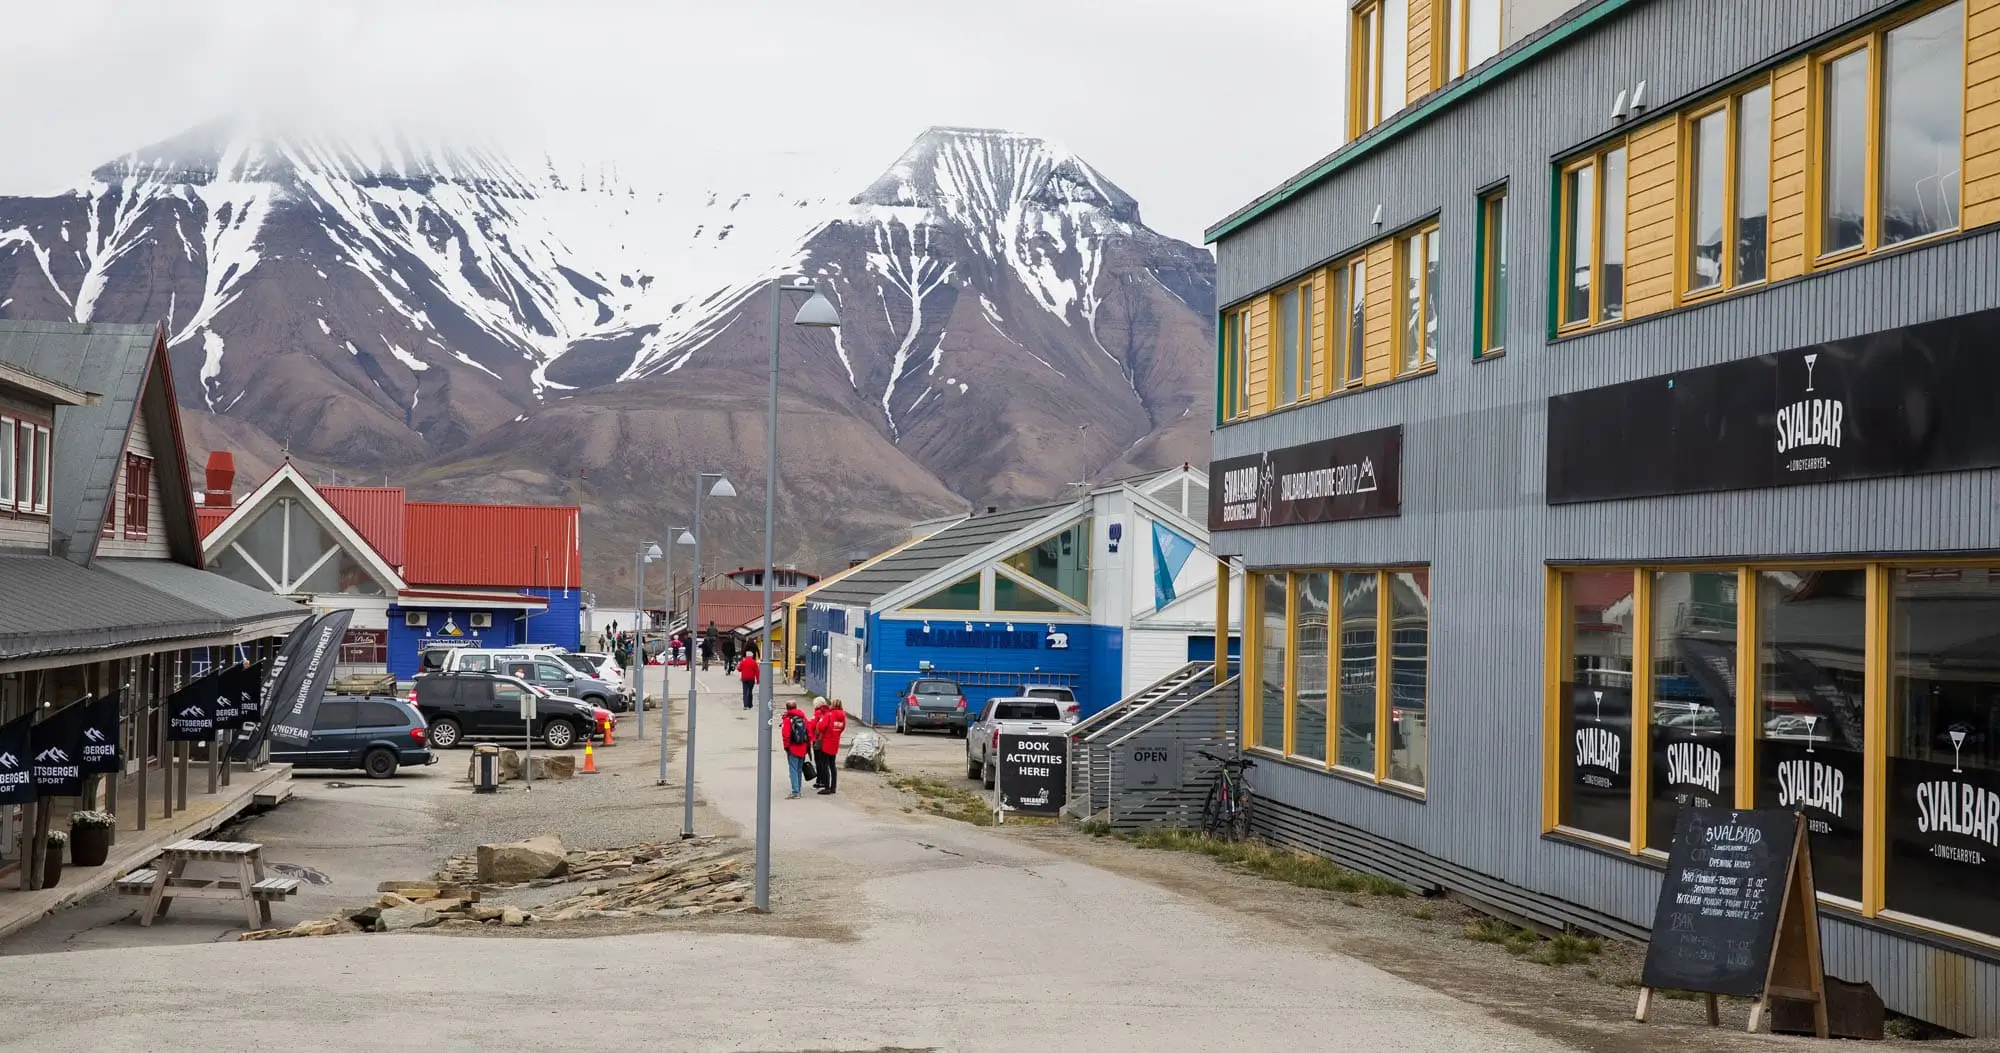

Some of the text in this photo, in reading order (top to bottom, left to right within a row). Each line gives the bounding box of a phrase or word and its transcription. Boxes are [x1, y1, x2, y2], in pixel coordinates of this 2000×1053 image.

[1776, 398, 1843, 453] SVALBAR
[1789, 457, 1827, 471] LONGYEARBYEN
[1223, 466, 1258, 503] SVALBARD
[1281, 463, 1358, 502] SVALBARD ADVENTURE GROUP
[1223, 502, 1257, 522] BOOKING.COM
[292, 677, 313, 715] BOOKING
[308, 625, 333, 673] EQUIPMENT
[171, 718, 213, 728] SPITSBERGEN
[270, 723, 309, 739] LONGYEAR
[83, 744, 115, 756] BERGEN
[1018, 741, 1050, 751] BOOK
[1576, 727, 1621, 775] SVALBAR
[1006, 753, 1063, 765] ACTIVITIES
[1134, 751, 1167, 762] OPEN
[1019, 766, 1050, 777] HERE!
[1667, 742, 1721, 795] SVALBAR
[37, 777, 65, 785] SPORT
[1777, 760, 1844, 818] SVALBAR
[1916, 781, 2000, 847] SVALBAR
[1706, 825, 1761, 844] SVALBARD
[1934, 844, 1981, 865] LONGYEARBYEN
